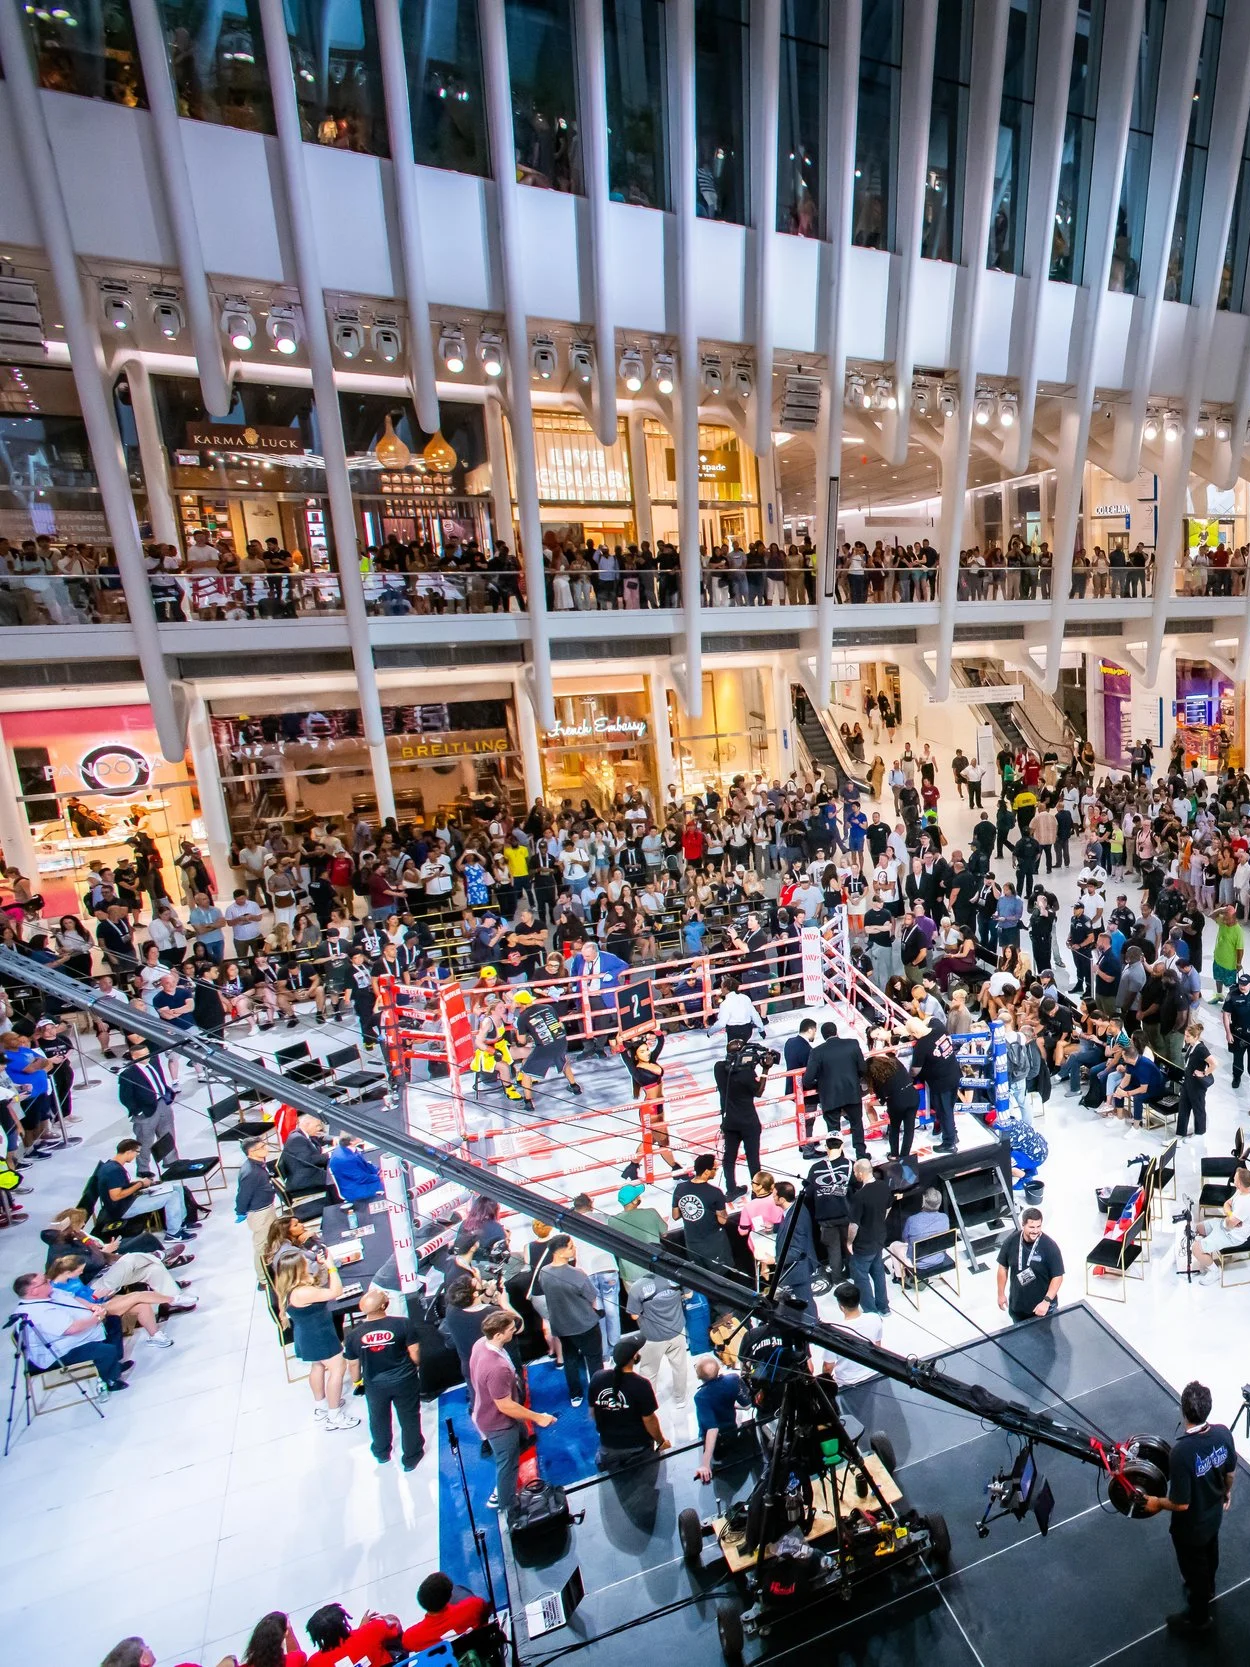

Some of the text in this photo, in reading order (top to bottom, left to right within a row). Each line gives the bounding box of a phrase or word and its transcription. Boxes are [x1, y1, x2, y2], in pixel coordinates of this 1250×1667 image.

[193, 435, 299, 449] KARMA LUCK
[547, 447, 606, 468] LIVE
[701, 463, 727, 473] spade
[536, 467, 626, 490] COLOR
[548, 716, 647, 738] French Embassy
[401, 738, 509, 760] BREITLING
[631, 993, 641, 1019] 2
[430, 1197, 461, 1219] NETFLIX
[366, 1332, 392, 1343] WBO
